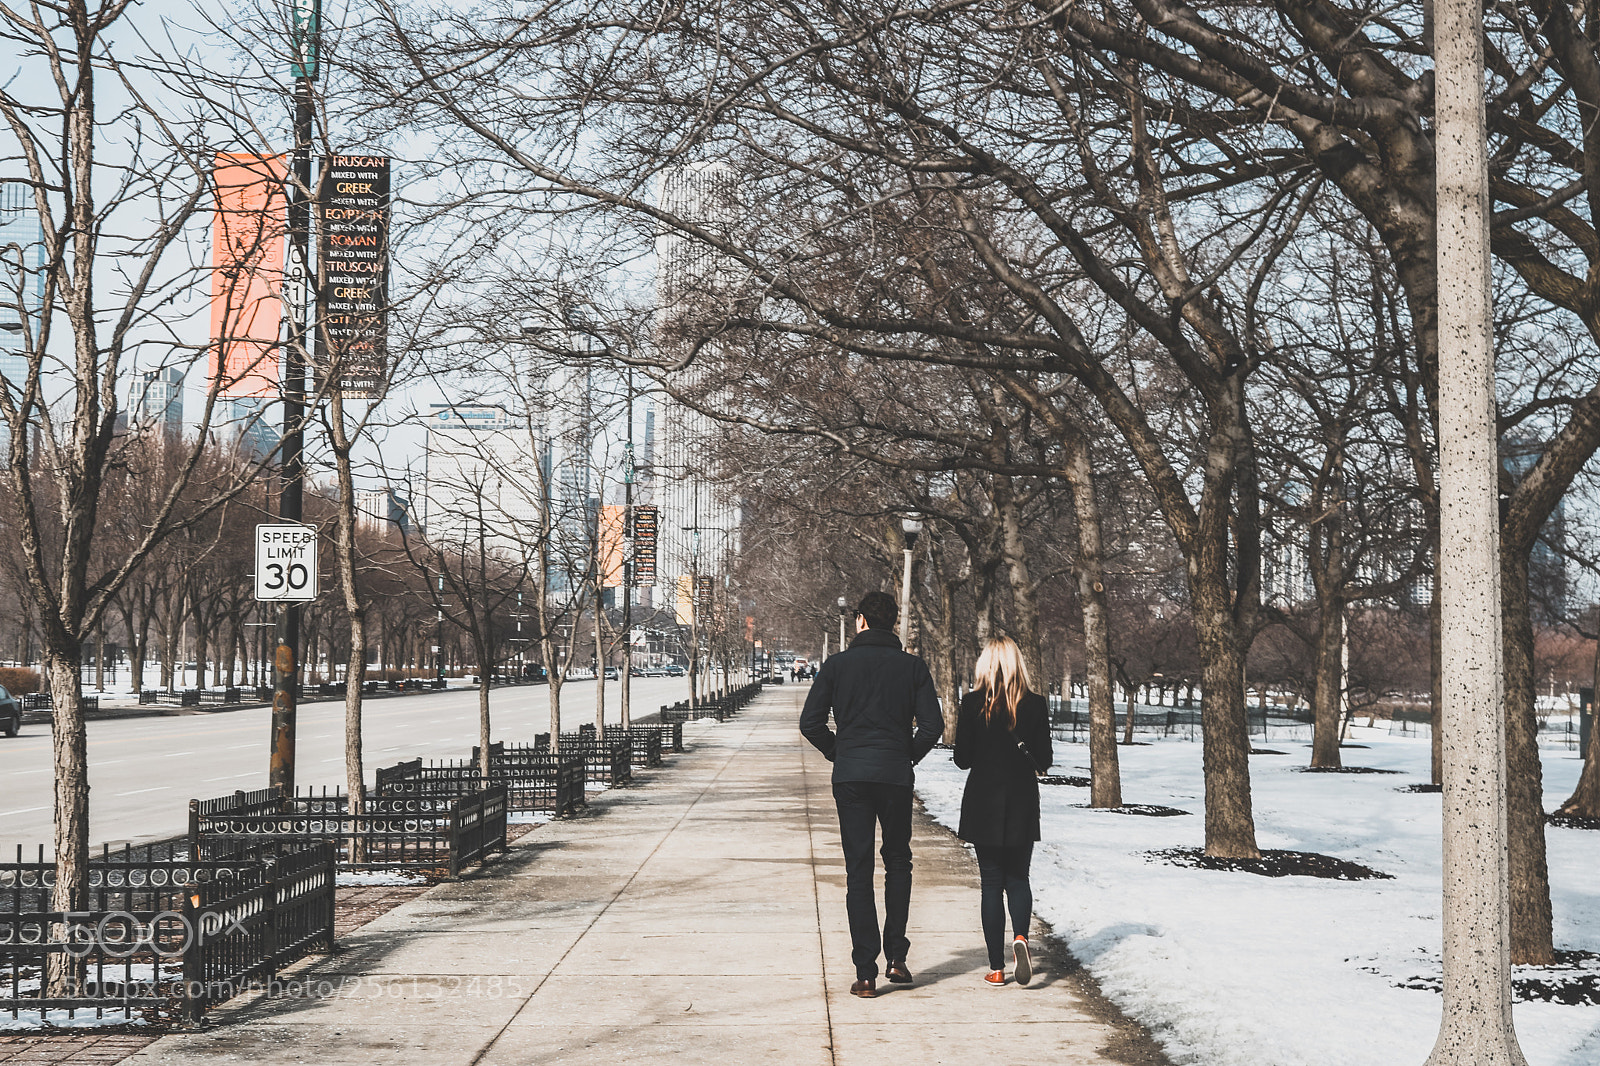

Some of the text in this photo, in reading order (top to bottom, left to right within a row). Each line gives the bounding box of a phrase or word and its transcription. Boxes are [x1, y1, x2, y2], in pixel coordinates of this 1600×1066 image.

[330, 171, 379, 180] MIXED WITH
[336, 182, 374, 195] GREEK
[330, 235, 377, 246] ROMAN
[355, 251, 377, 259] WITH
[328, 276, 354, 284] MIXED
[262, 532, 311, 544] SPEED
[267, 547, 306, 559] LIMIT
[264, 563, 308, 590] 30
